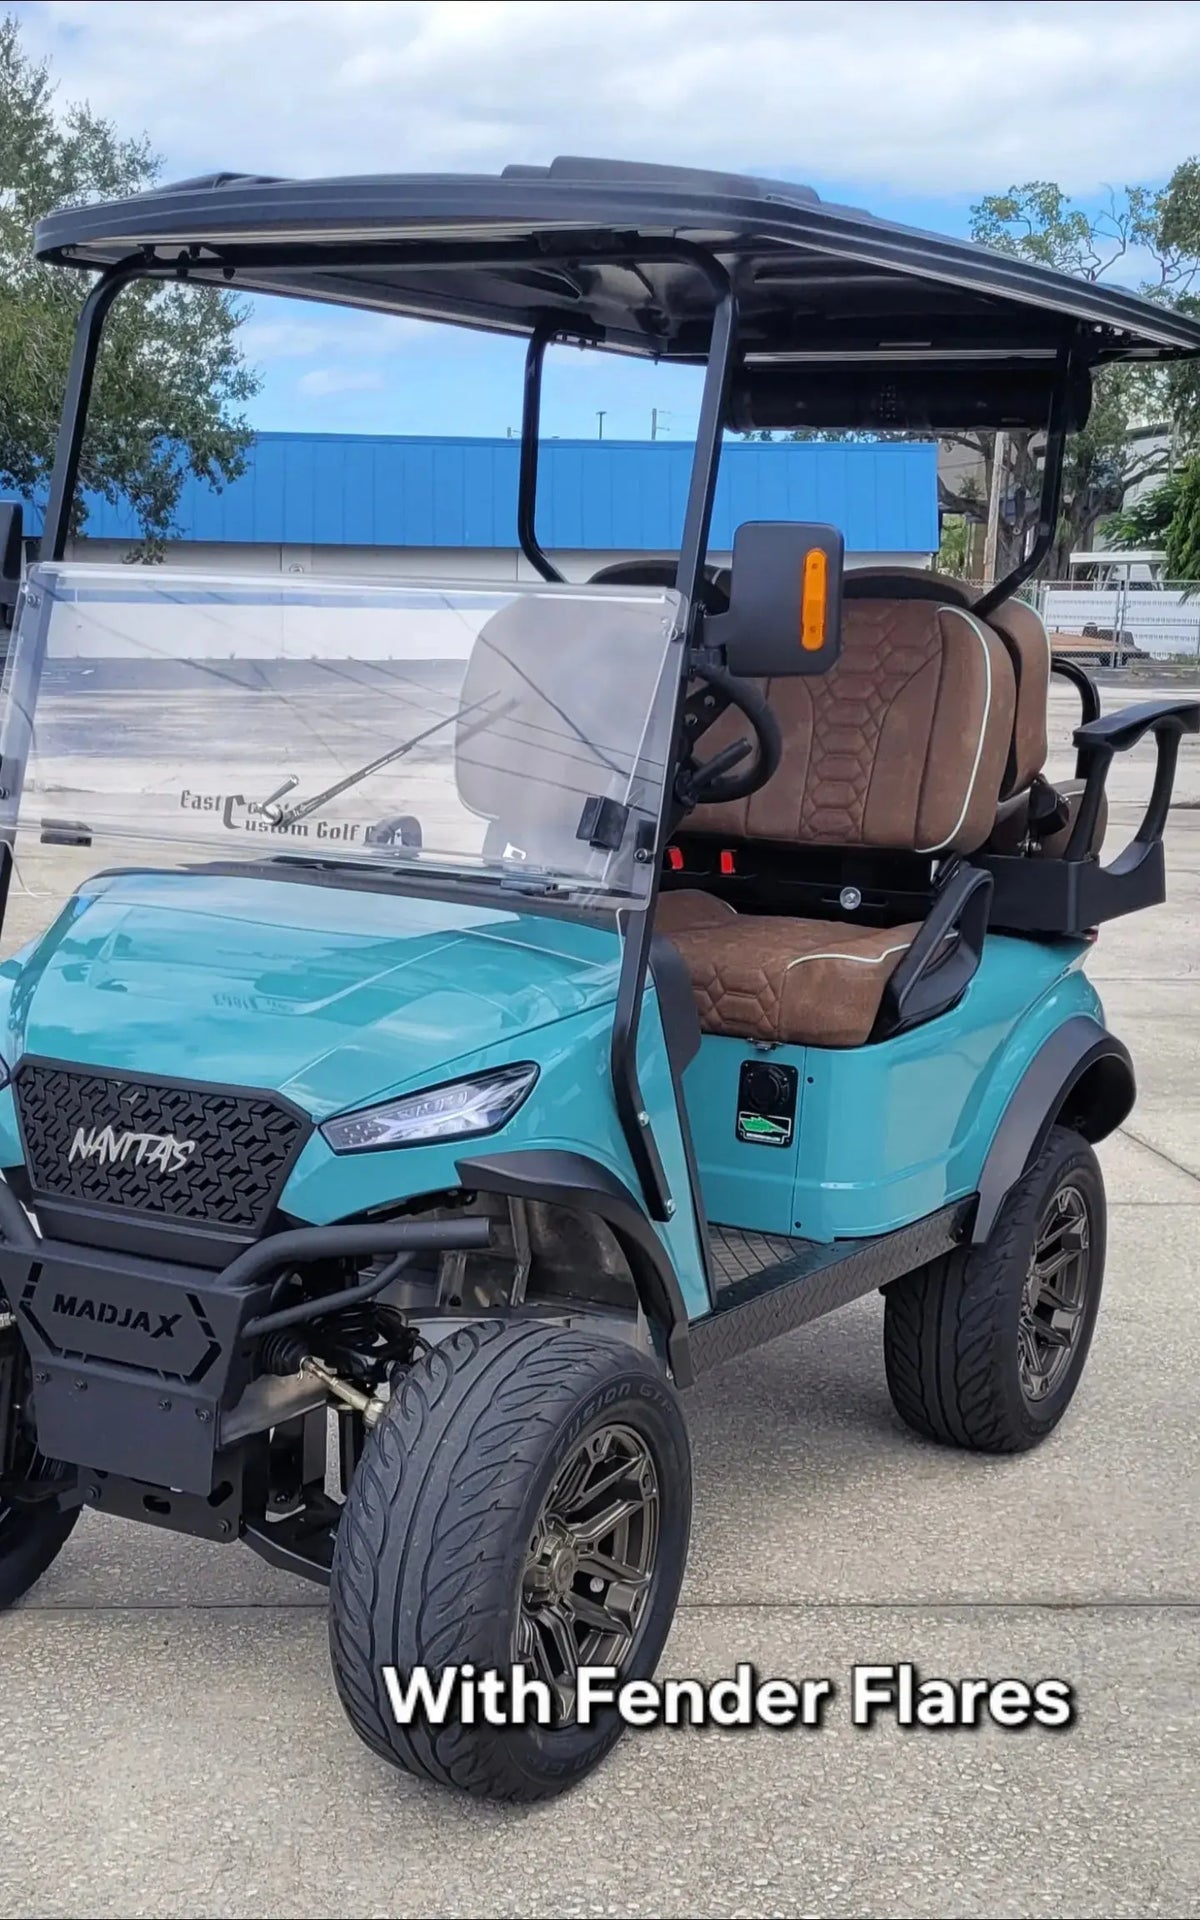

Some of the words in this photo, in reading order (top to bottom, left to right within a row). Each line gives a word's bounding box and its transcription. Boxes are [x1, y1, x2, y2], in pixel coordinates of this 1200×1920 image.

[180, 789, 221, 811] East
[316, 821, 361, 841] Golf
[69, 1125, 196, 1172] NAVITAS
[53, 1294, 183, 1340] MADJAX
